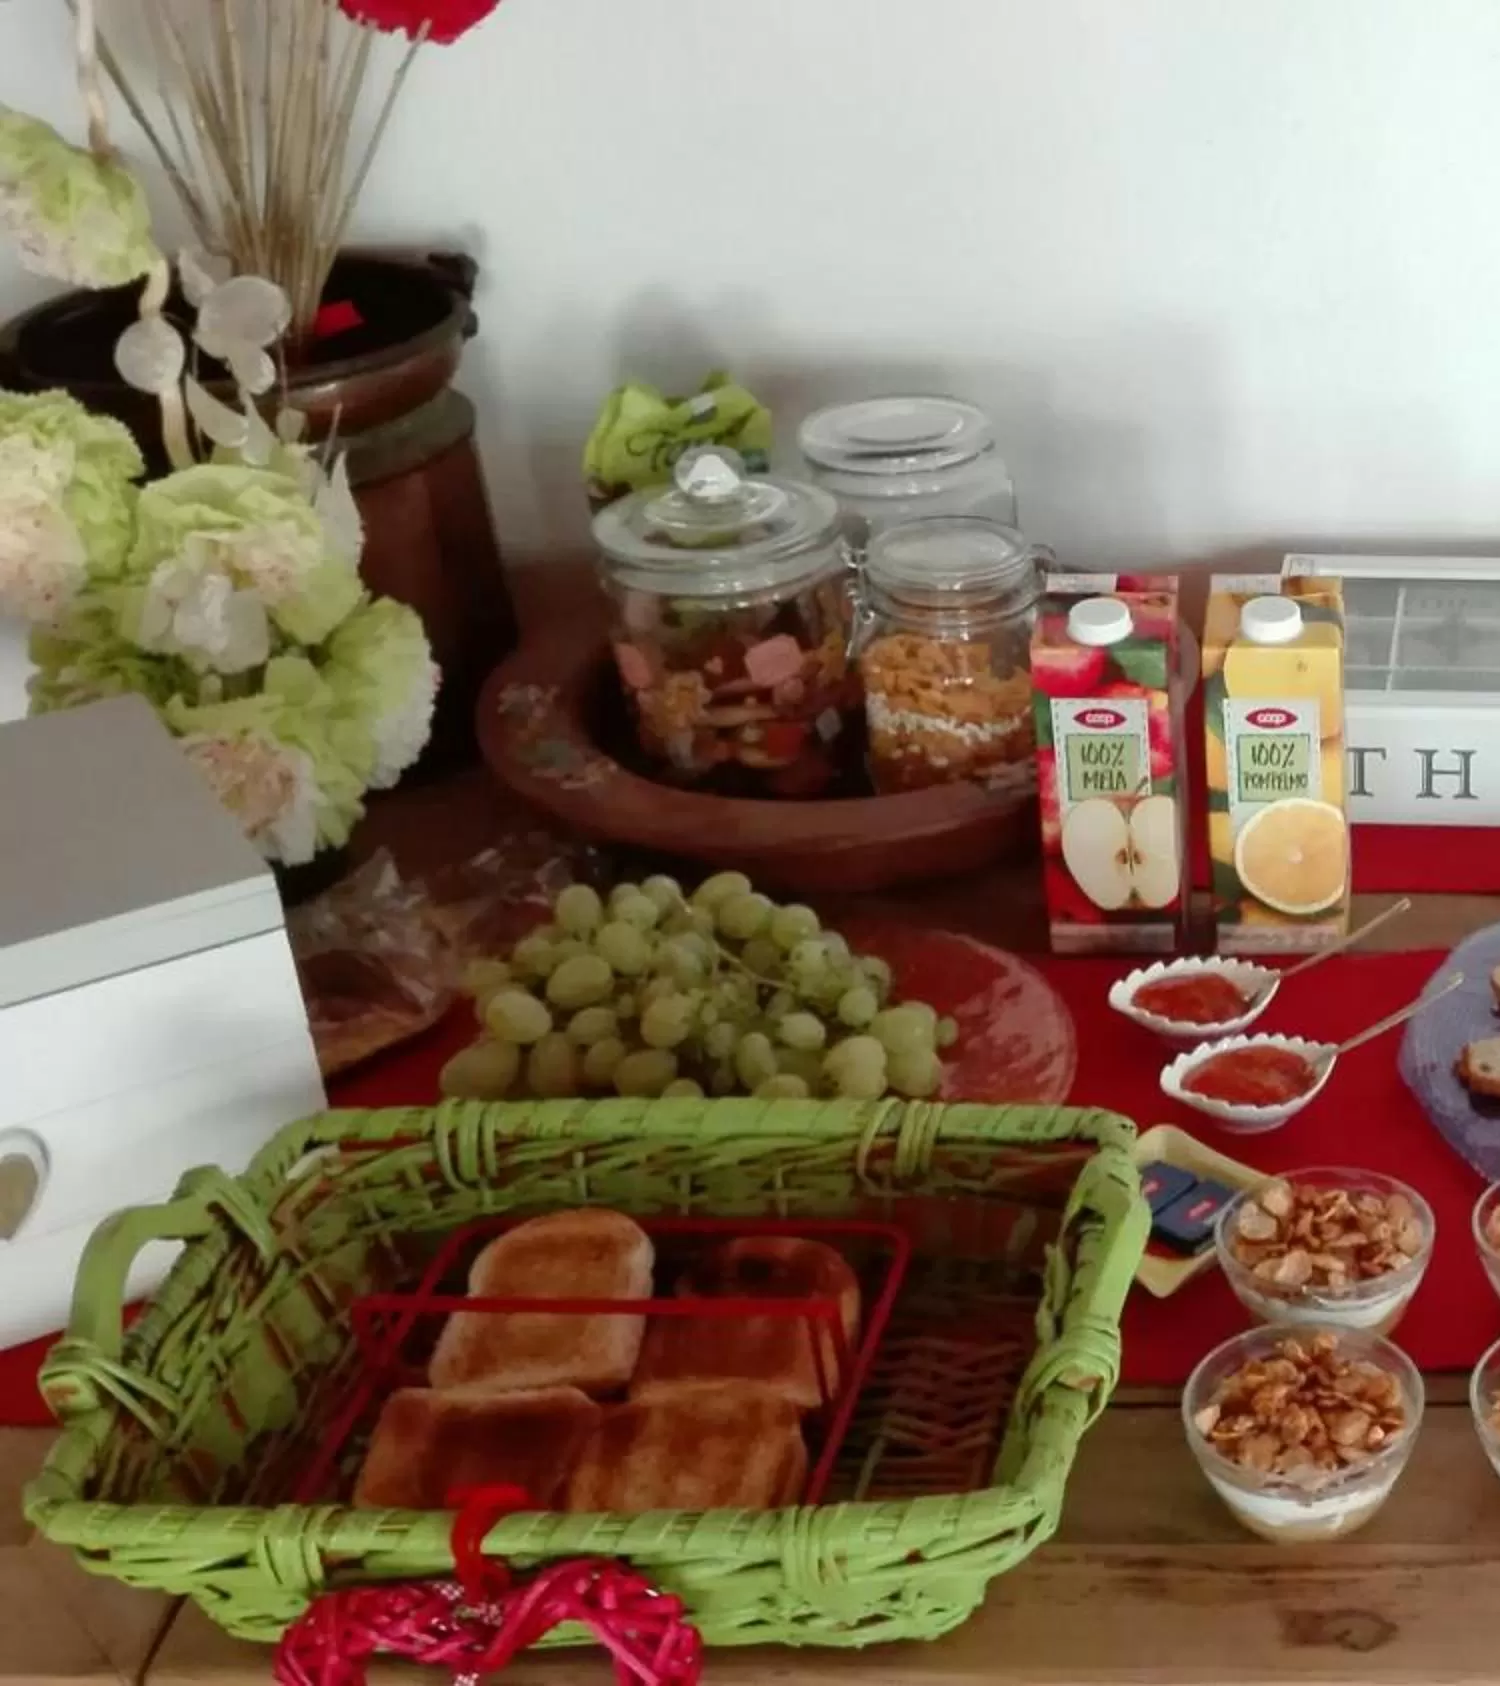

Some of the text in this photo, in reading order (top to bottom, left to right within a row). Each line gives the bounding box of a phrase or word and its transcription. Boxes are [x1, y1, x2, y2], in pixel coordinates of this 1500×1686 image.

[1081, 741, 1125, 768] 100%
[1251, 742, 1295, 768] 100%
[1083, 769, 1127, 790] MELA
